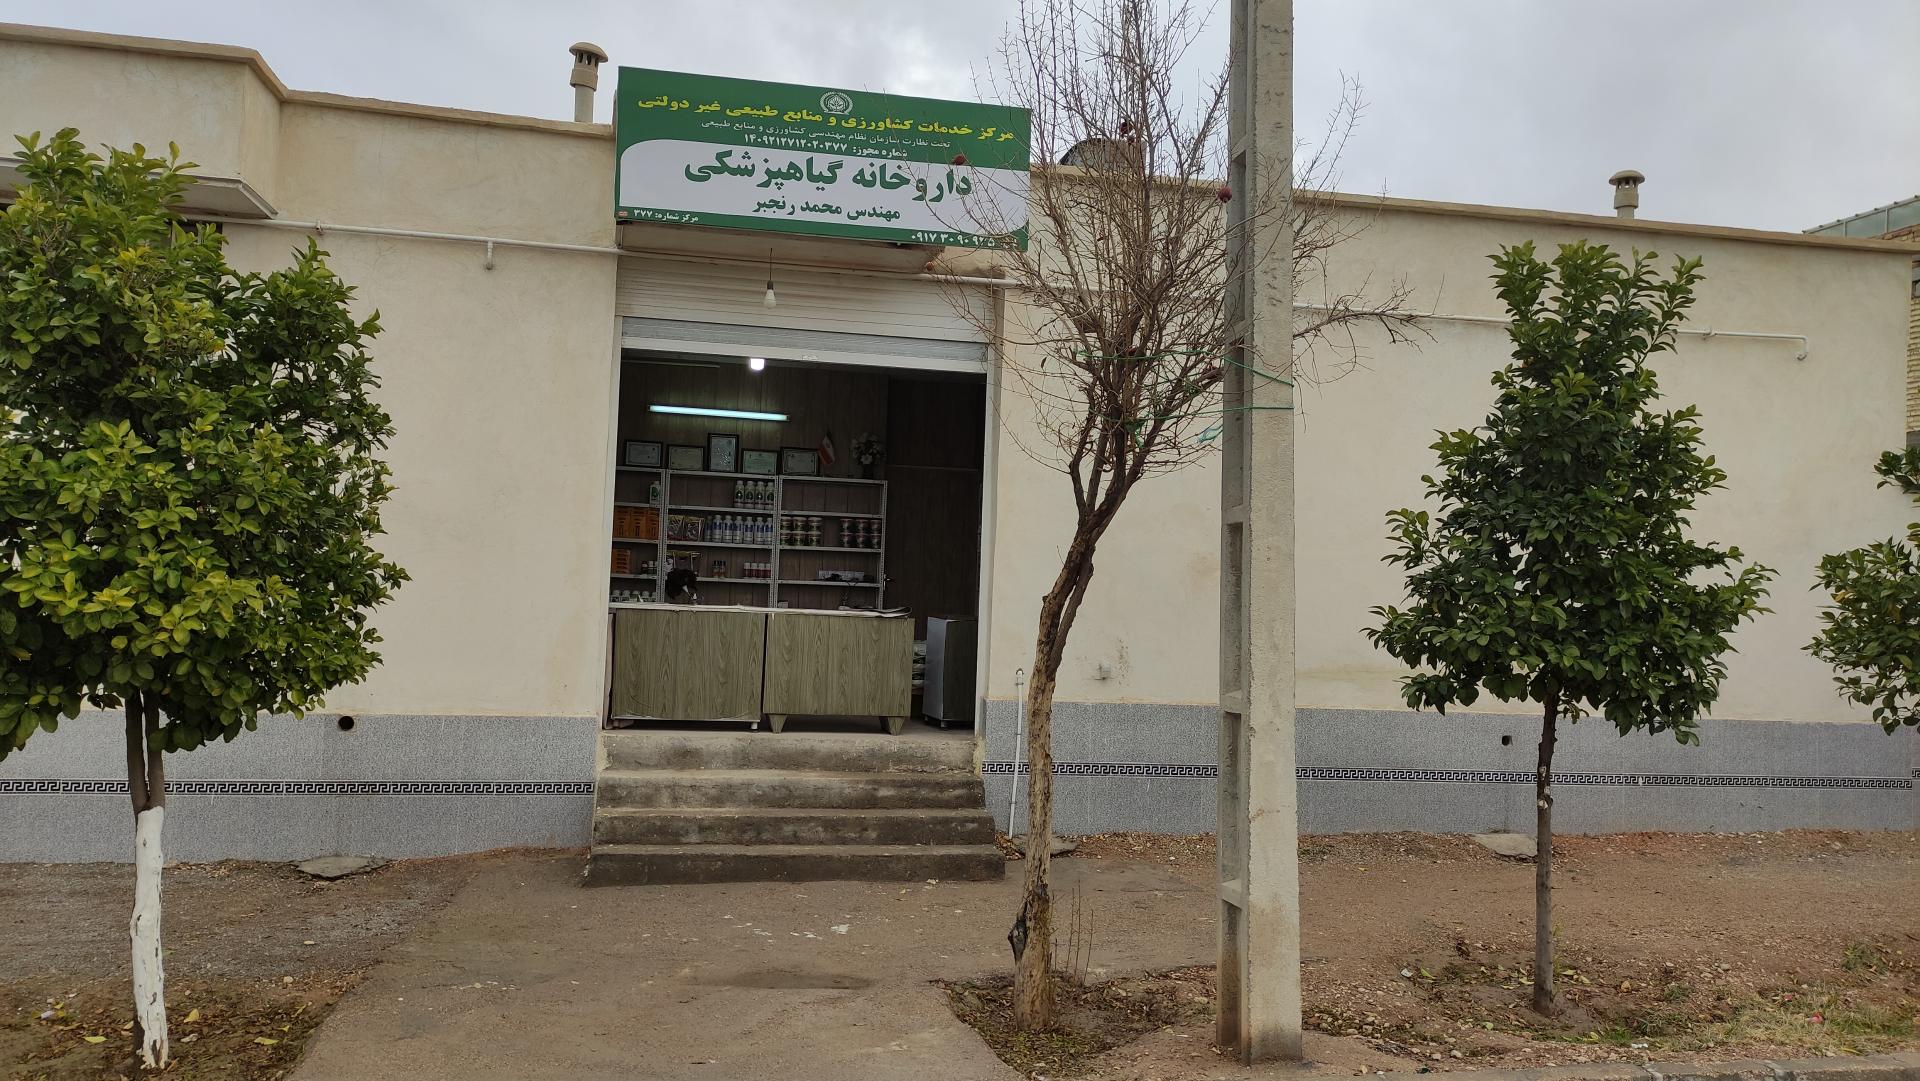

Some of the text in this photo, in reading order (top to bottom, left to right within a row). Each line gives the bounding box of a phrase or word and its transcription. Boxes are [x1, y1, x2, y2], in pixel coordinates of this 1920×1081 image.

[638, 95, 1014, 141] مرکز خدمات کشاورزی و منابع طبیعی غیر دولتی
[702, 120, 730, 128] طبیعی
[734, 122, 756, 130] منابع
[766, 126, 806, 135] کشاورزی
[808, 130, 846, 140] مهندسی
[848, 132, 866, 140] نظام
[870, 136, 900, 145] سازمان
[902, 138, 928, 146] نظارت
[882, 148, 908, 158] شماره
[684, 150, 972, 202] داروخانه گیاهپزشکی
[752, 195, 900, 222] مهندس محمد رنجبر
[634, 209, 652, 218] ۳۷۷
[682, 214, 698, 222] مرکز
